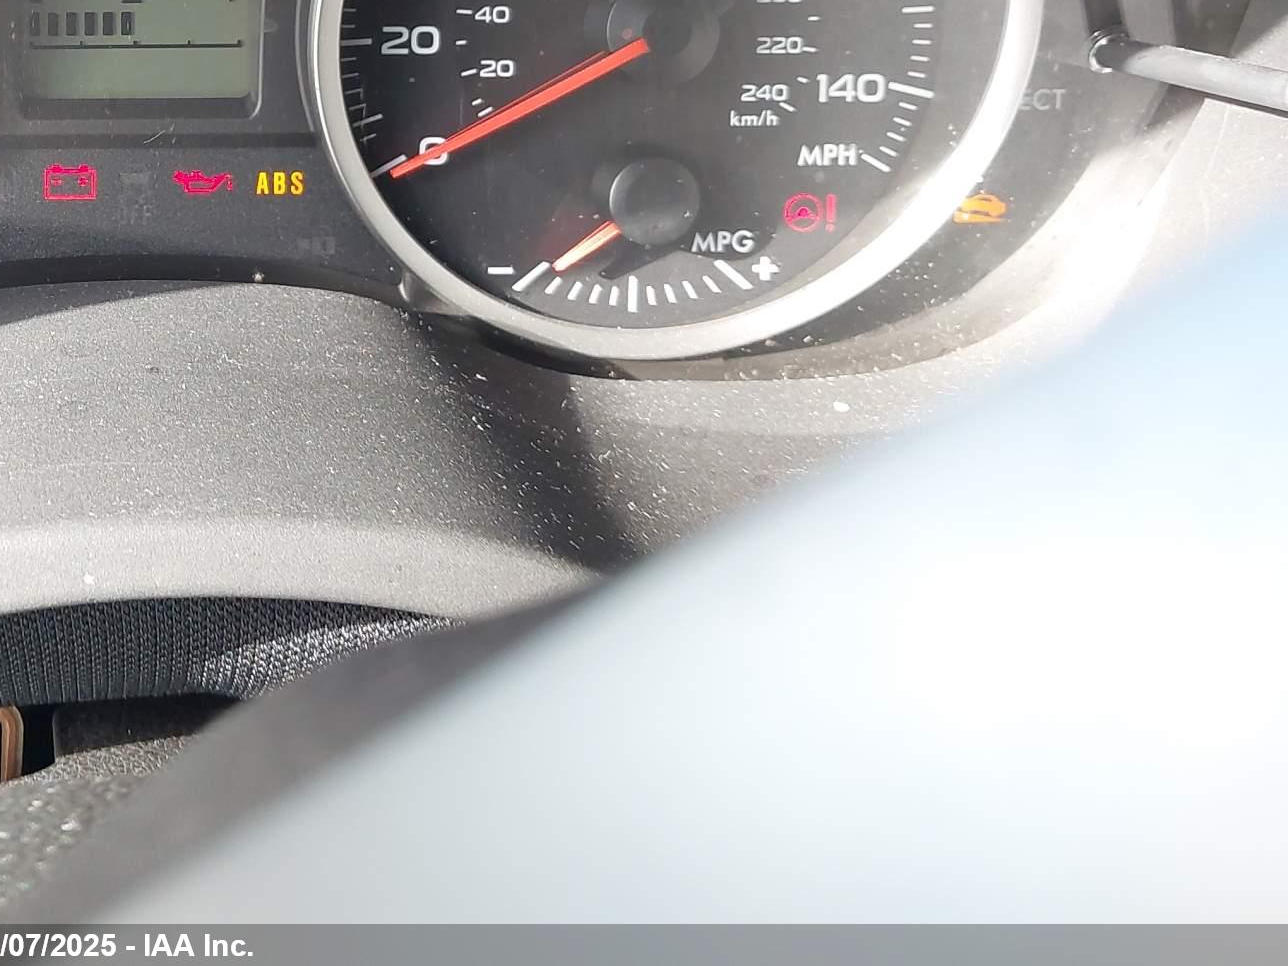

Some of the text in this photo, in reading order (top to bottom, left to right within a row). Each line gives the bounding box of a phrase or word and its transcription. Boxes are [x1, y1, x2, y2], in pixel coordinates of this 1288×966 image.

[475, 6, 509, 23] 40
[382, 26, 440, 54] 20
[757, 37, 802, 53] 220
[480, 60, 514, 77] 20
[741, 85, 788, 101] 240
[817, 74, 885, 102] 140
[730, 110, 779, 126] km/h
[418, 136, 449, 165] 0
[798, 144, 857, 166] MPH
[257, 172, 303, 194] ABS
[692, 230, 754, 253] MPG
